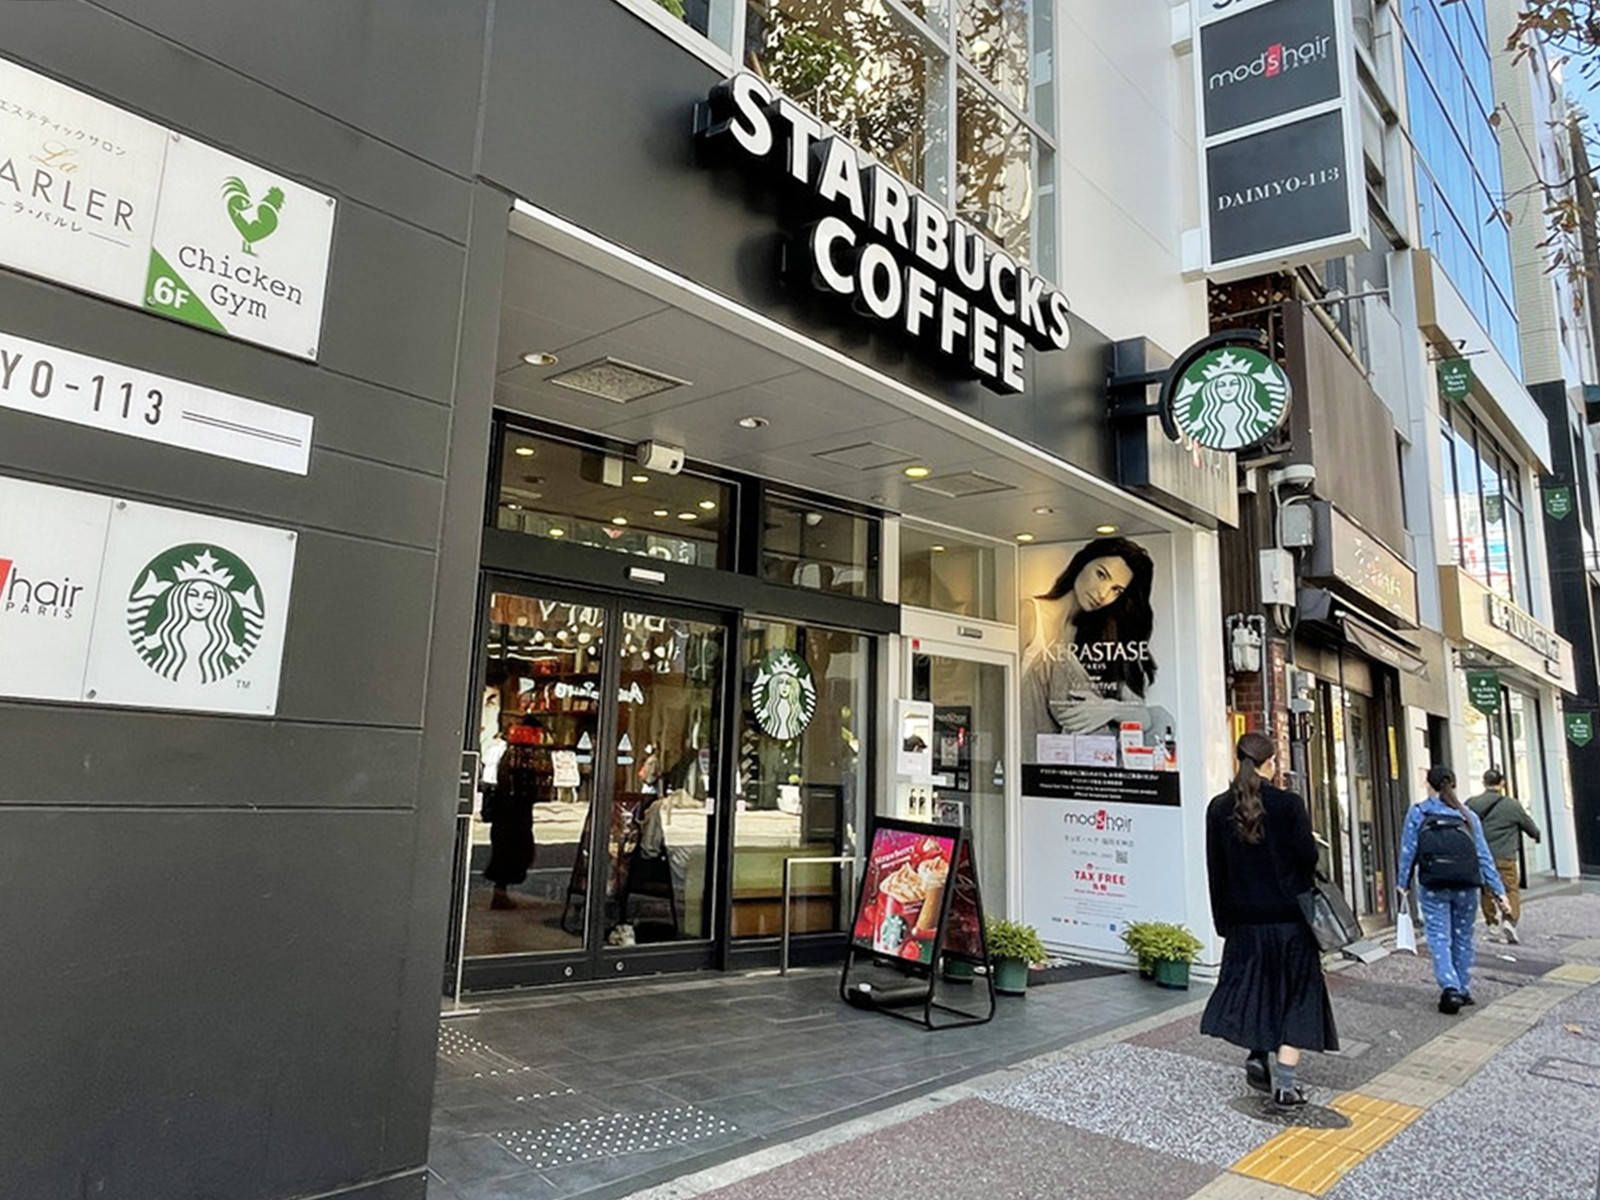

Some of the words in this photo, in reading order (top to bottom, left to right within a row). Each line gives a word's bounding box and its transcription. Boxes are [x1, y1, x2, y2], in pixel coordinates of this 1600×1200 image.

[28, 140, 79, 175] La
[1217, 166, 1340, 212] DAIMYO-113
[729, 72, 1072, 351] STARBUCKS
[153, 276, 191, 310] 6F
[178, 245, 304, 306] Chicken
[210, 283, 269, 320] Gym
[812, 215, 1026, 394] COFFEE
[0, 348, 164, 426] YO-113
[7, 566, 84, 608] hair
[5, 601, 74, 620] PARIS
